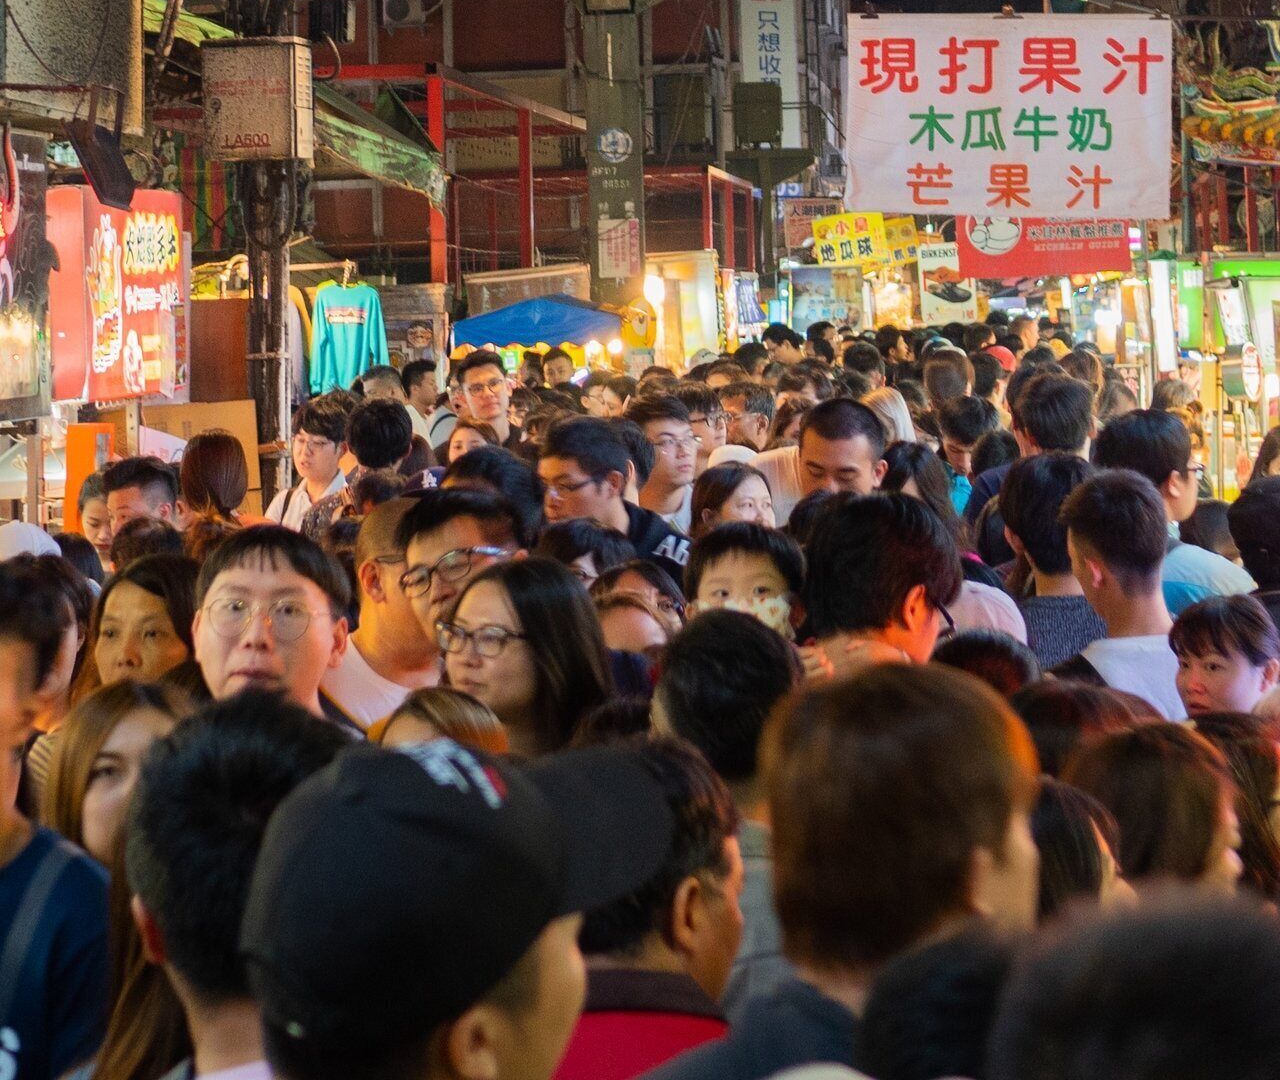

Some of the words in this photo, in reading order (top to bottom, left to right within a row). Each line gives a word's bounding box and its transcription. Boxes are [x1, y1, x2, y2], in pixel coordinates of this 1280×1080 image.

[858, 35, 1165, 96] 現打果汁
[907, 104, 1113, 153] 木瓜牛奶
[906, 161, 1113, 210] 芒果汁
[1033, 241, 1084, 252] MICHELIN
